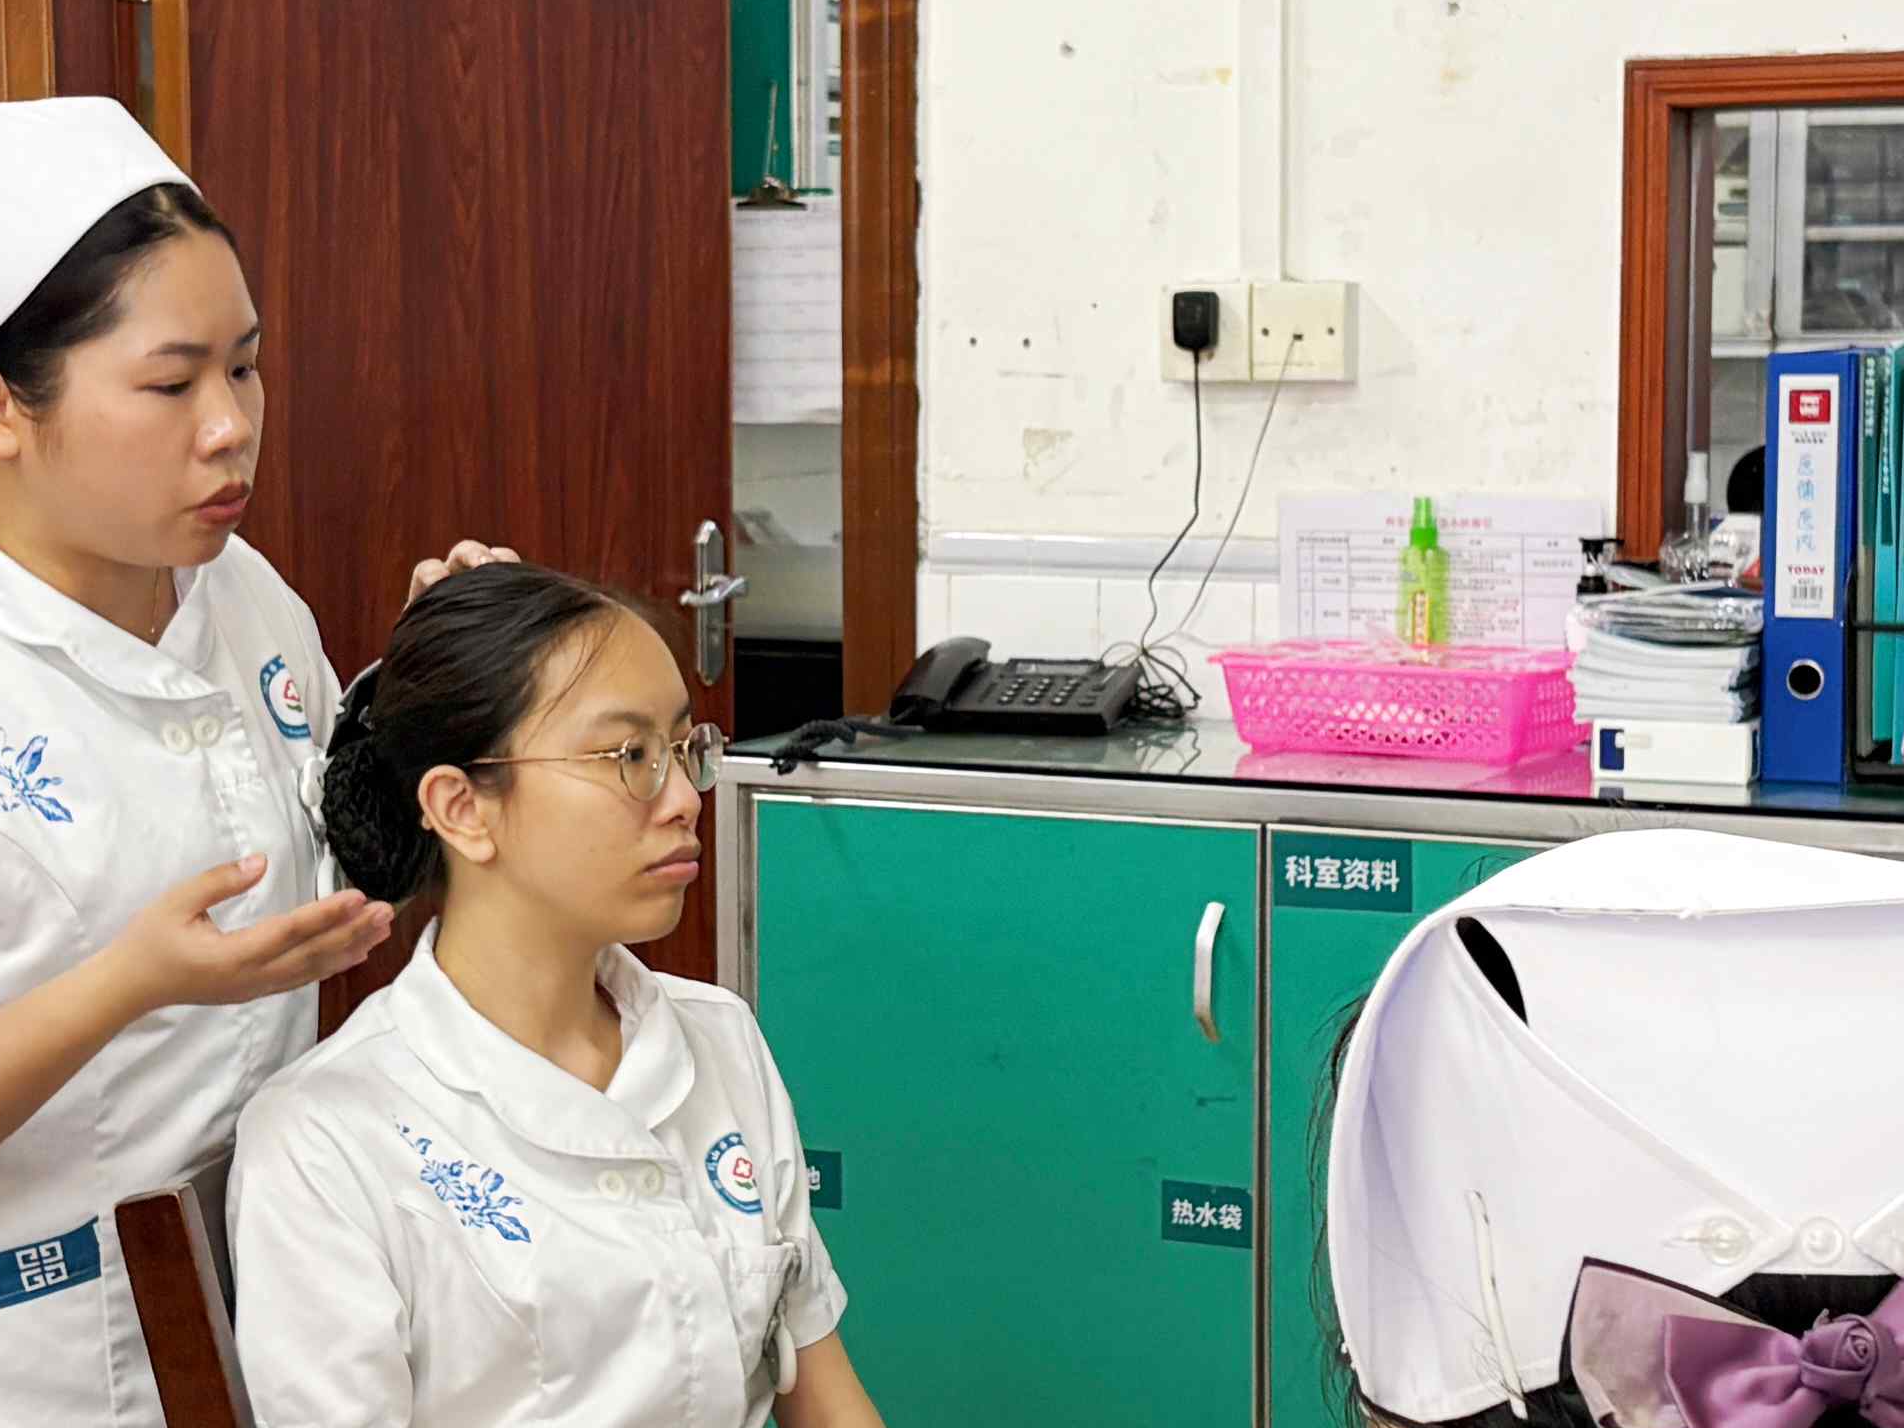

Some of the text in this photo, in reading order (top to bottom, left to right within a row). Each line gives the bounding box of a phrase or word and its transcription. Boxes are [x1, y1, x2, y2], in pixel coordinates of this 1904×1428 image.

[1285, 855, 1400, 893] 科室资料
[1171, 1198, 1243, 1232] 热水袋
